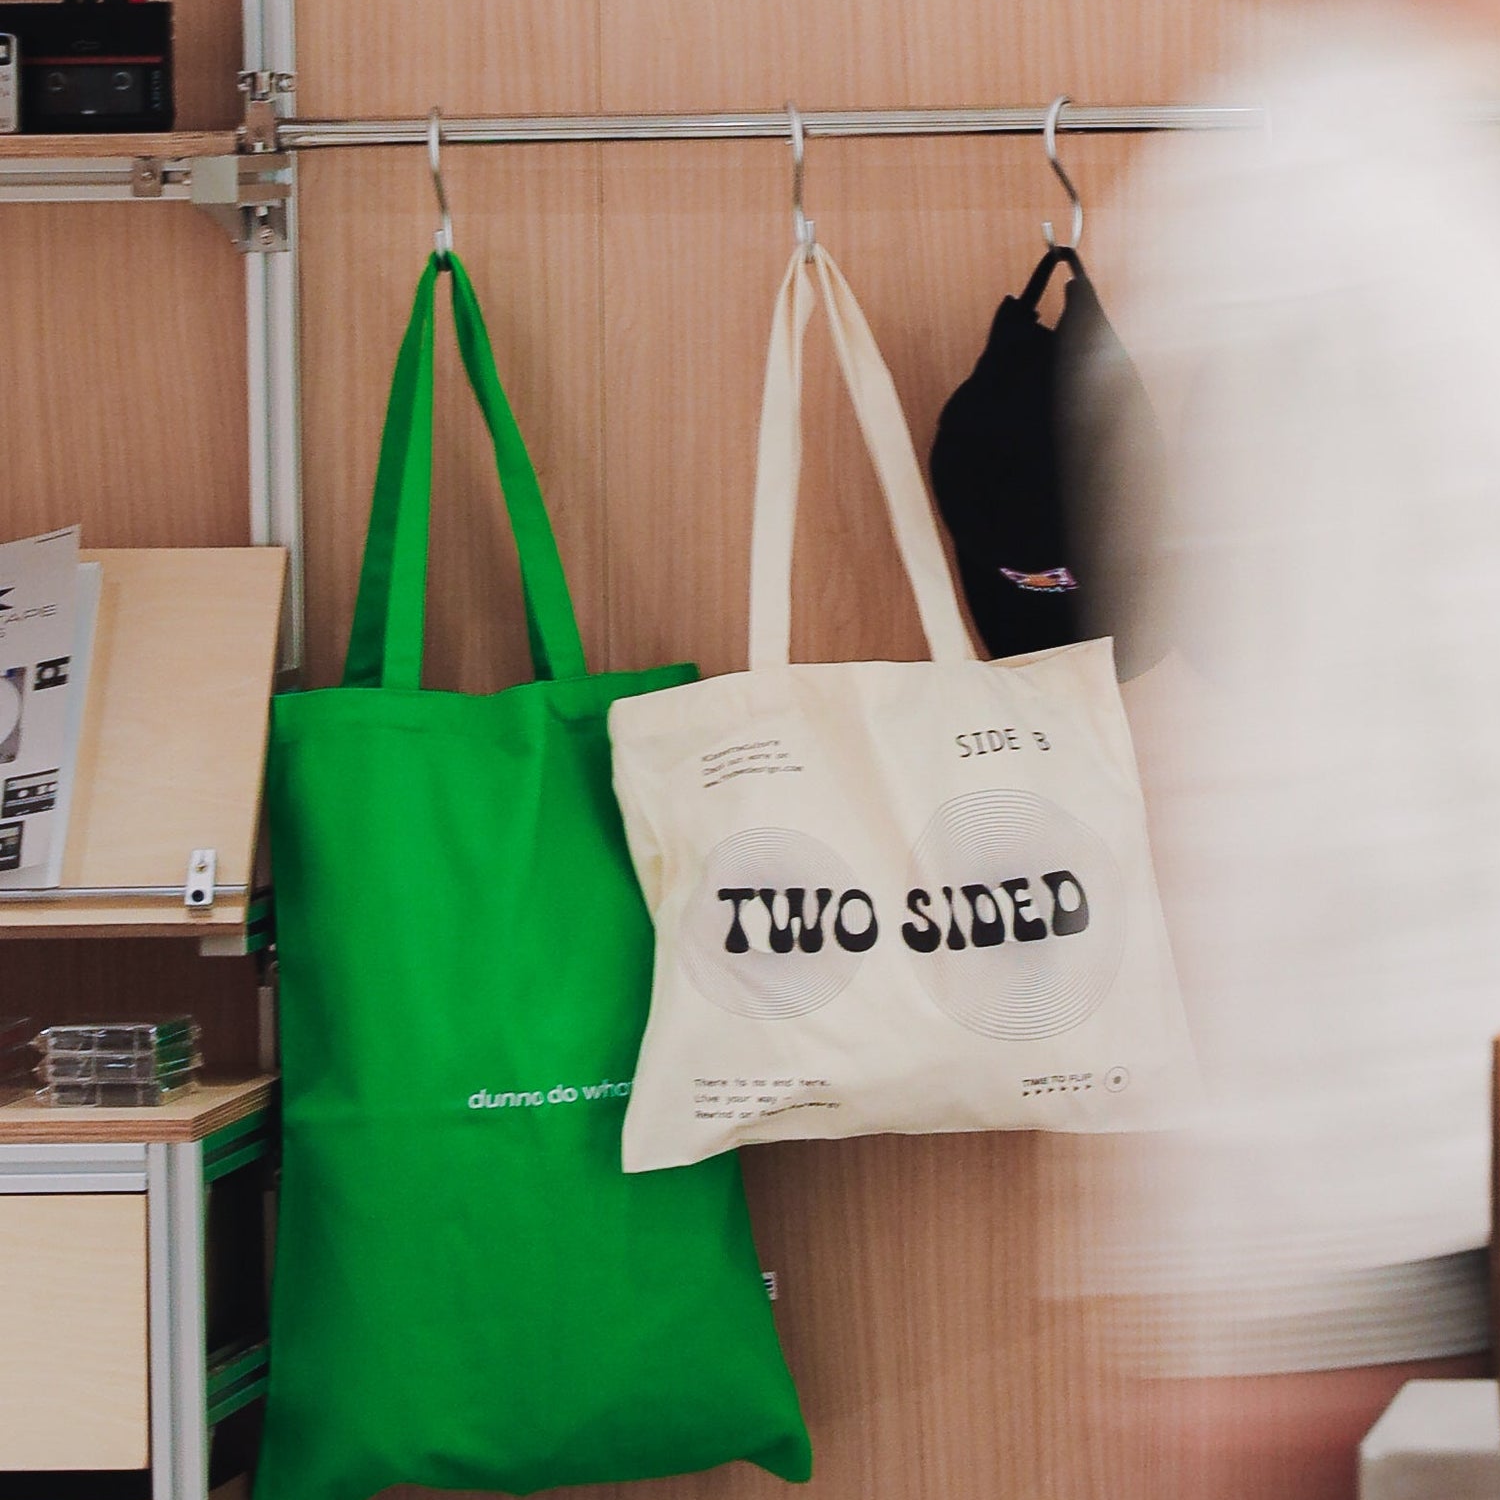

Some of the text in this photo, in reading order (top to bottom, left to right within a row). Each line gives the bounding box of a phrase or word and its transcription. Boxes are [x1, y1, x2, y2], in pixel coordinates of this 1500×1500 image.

[0, 603, 57, 624] APE
[956, 728, 1021, 758] SIDE
[717, 870, 1089, 954] TWO SIDED
[468, 1078, 633, 1109] dunno do wha
